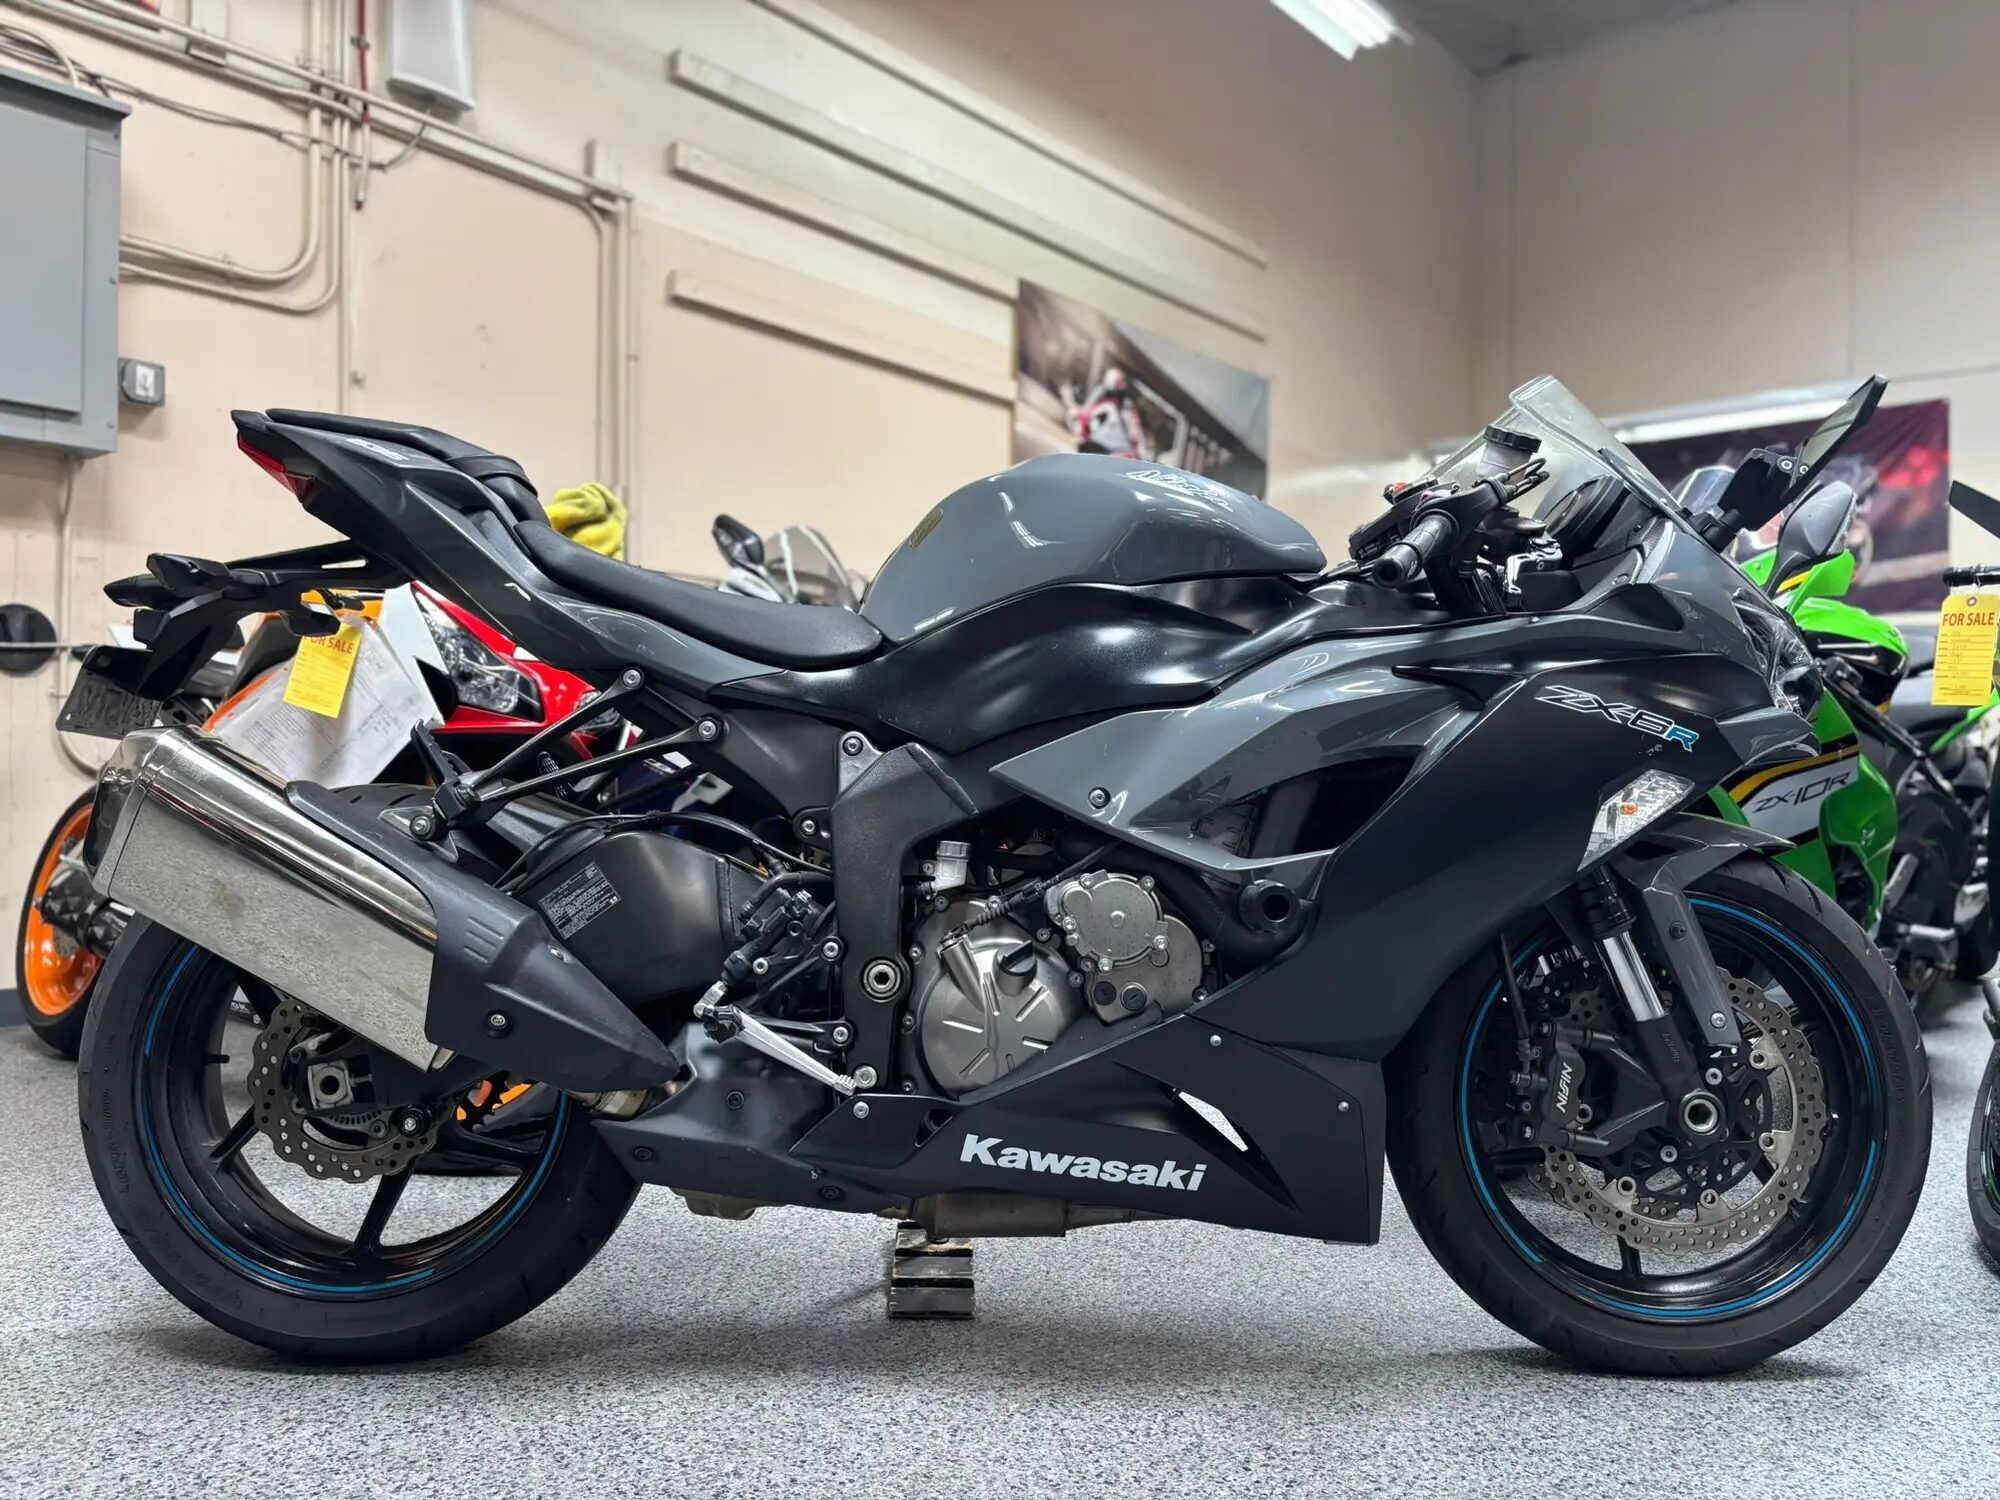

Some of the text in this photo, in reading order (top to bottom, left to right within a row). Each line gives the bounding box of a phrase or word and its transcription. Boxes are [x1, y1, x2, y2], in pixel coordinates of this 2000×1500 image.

[1942, 612, 1995, 627] FOR SALE
[303, 636, 354, 654] OR SALE
[1533, 684, 1700, 753] ZX-6R
[1752, 771, 1851, 814] ZX-10R
[1556, 1061, 1573, 1113] NISSIN
[960, 1133, 1208, 1191] Kawasaki
